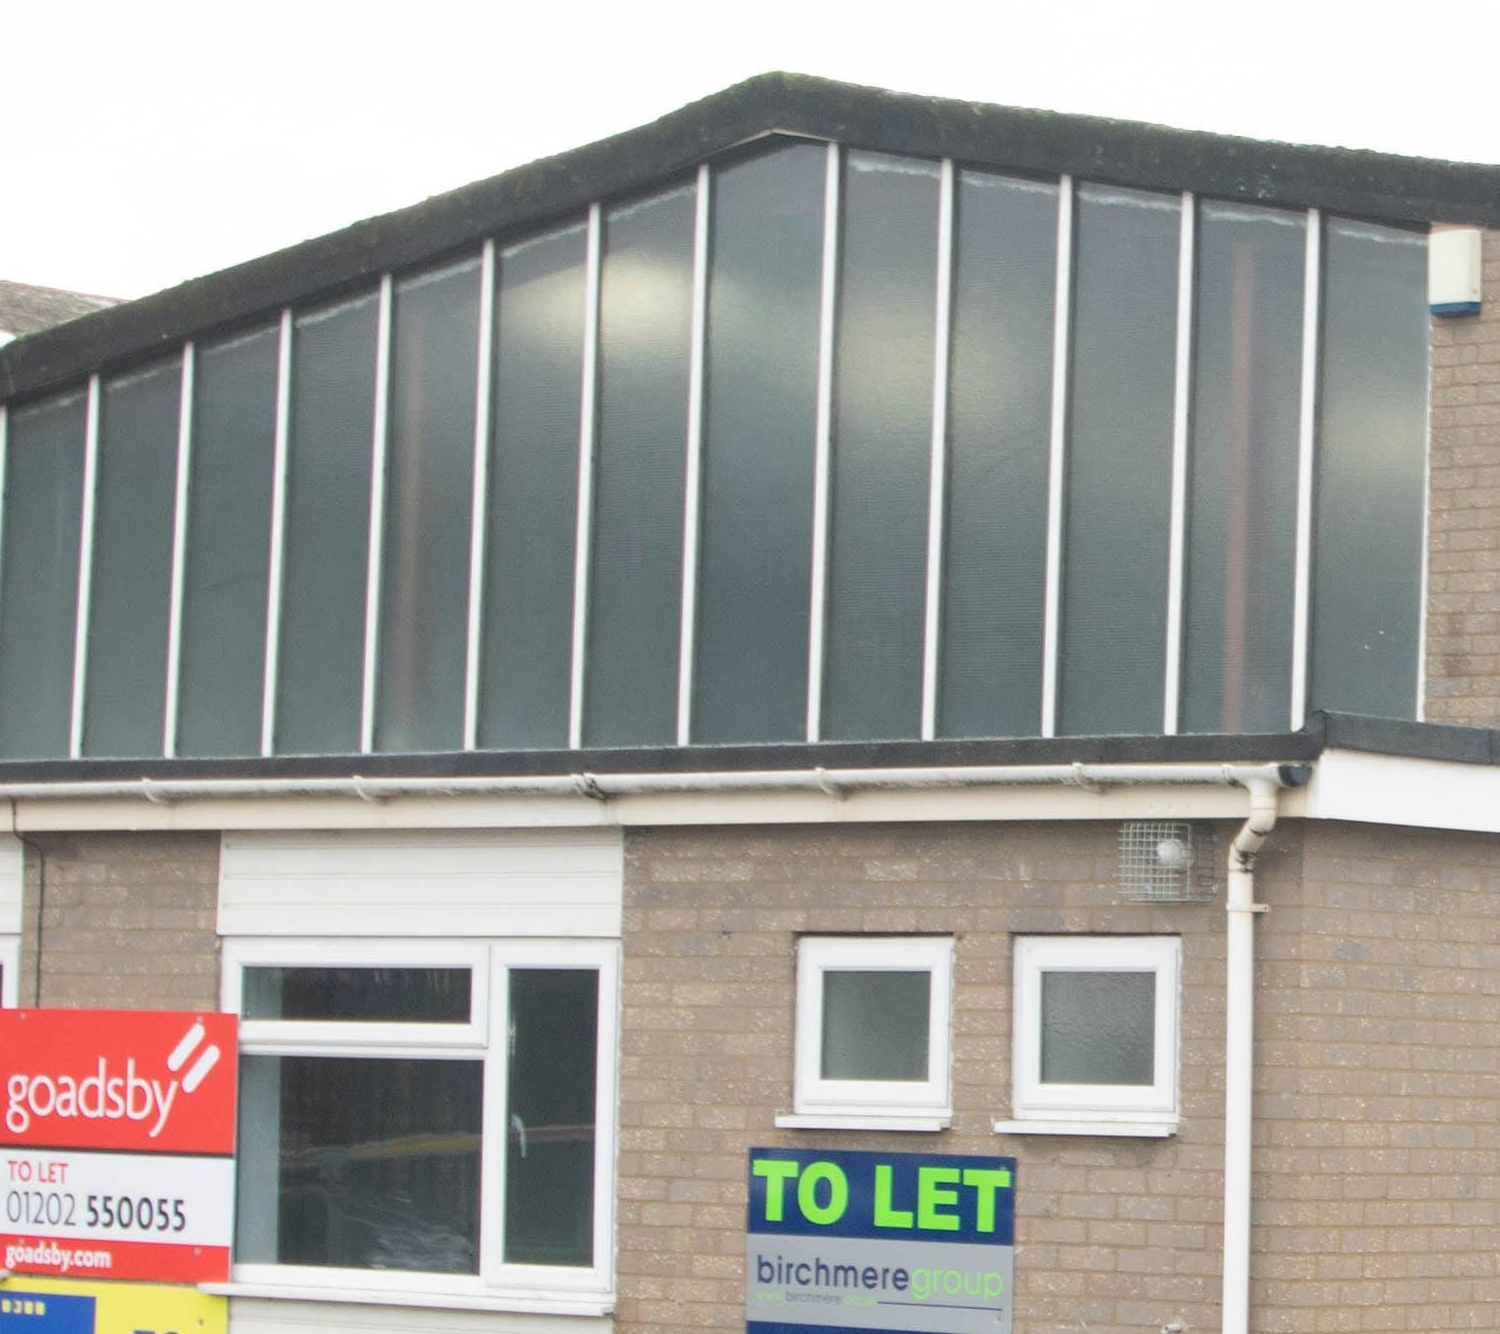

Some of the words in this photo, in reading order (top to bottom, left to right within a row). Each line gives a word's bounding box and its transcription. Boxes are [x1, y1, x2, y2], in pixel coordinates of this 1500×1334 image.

[6, 1057, 178, 1138] goadsby
[8, 1160, 32, 1183] TO
[38, 1163, 68, 1185] LET
[7, 1191, 76, 1227] 01202
[87, 1196, 186, 1233] 550055
[753, 1159, 849, 1225] TO
[873, 1165, 1012, 1233] LET
[5, 1243, 112, 1273] goadsby.com
